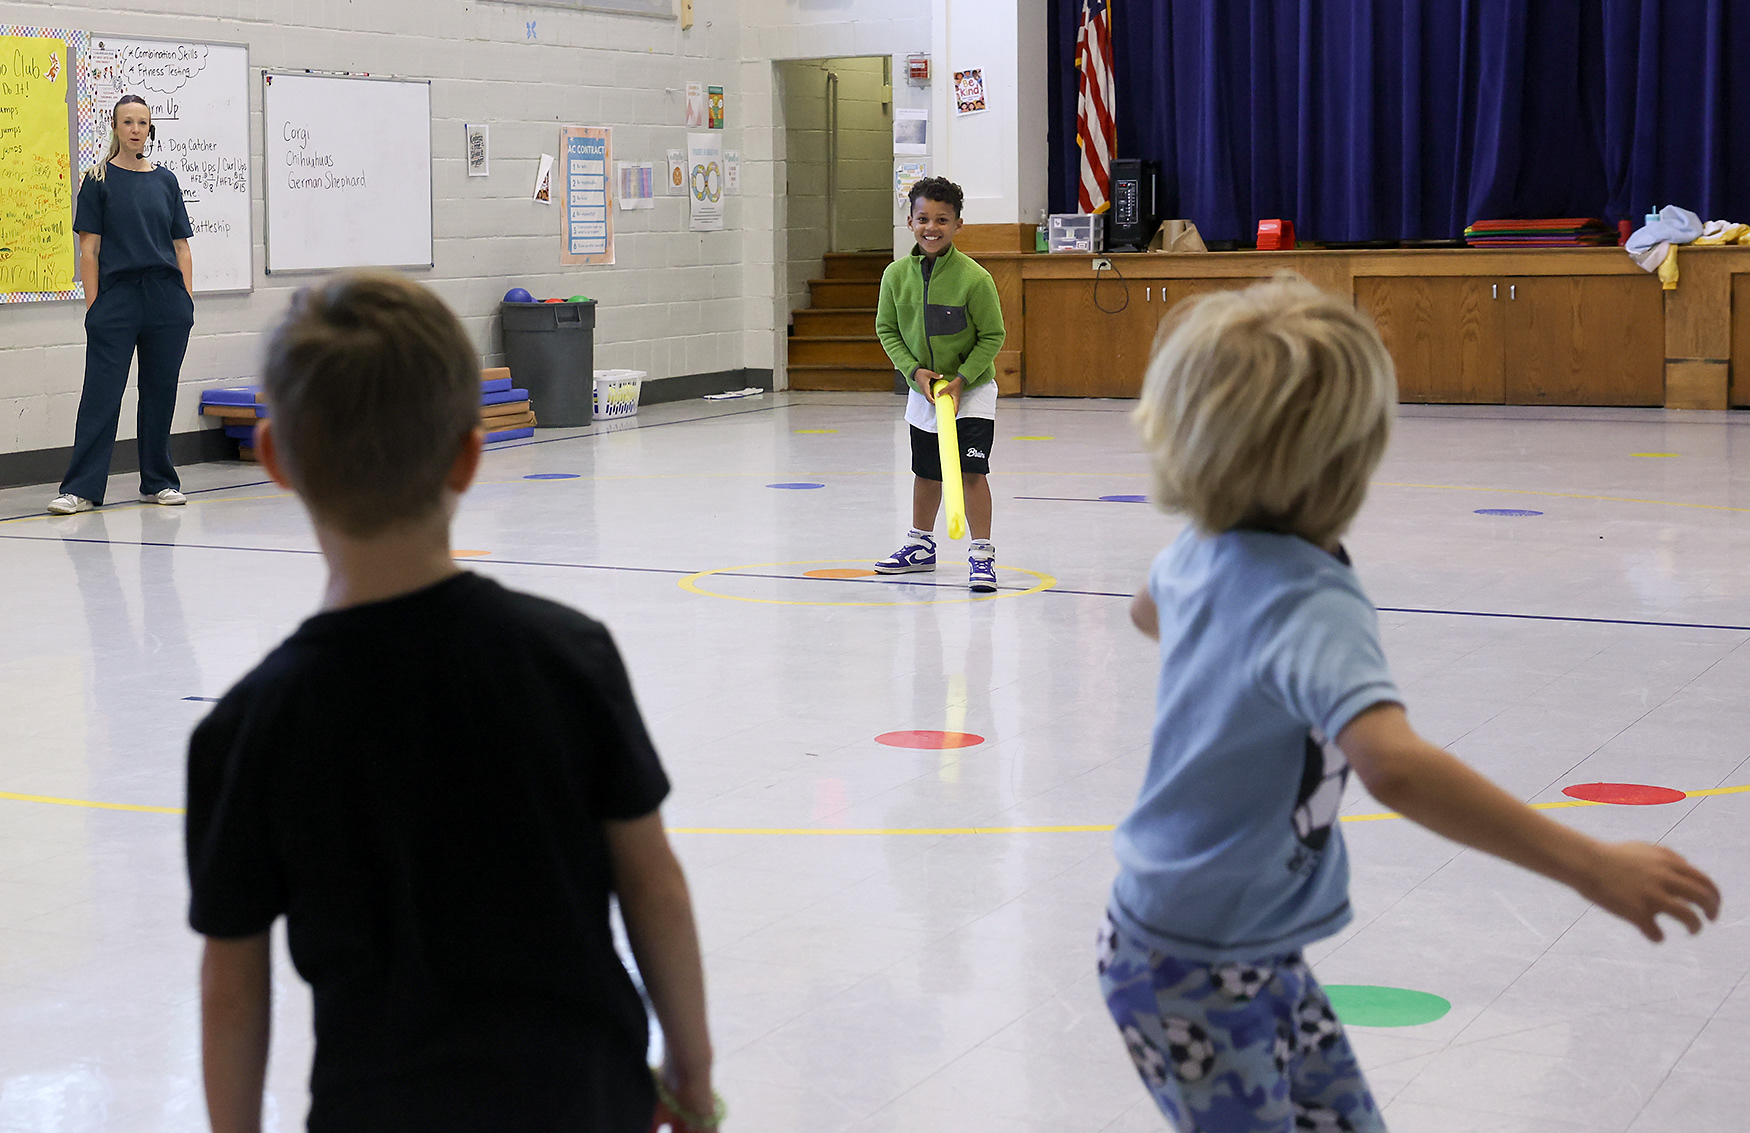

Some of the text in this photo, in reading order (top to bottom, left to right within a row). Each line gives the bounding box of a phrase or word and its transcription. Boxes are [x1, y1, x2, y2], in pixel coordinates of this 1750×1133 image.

[135, 46, 198, 61] Combination Skills
[14, 49, 40, 79] Club
[138, 63, 190, 78] Fitness Testing
[3, 82, 13, 95] Do
[960, 84, 980, 97] kind
[963, 79, 975, 88] Be
[167, 98, 179, 119] Up
[283, 120, 310, 150] Corgi
[169, 139, 188, 157] Dog
[189, 138, 218, 152] Catcher
[577, 145, 606, 155] CONTRACT
[180, 157, 200, 172] Push
[202, 161, 217, 176] Ups
[286, 150, 335, 169] Chihuahuas
[288, 170, 323, 189] German
[572, 179, 577, 187] 2
[189, 217, 232, 237] Battleship
